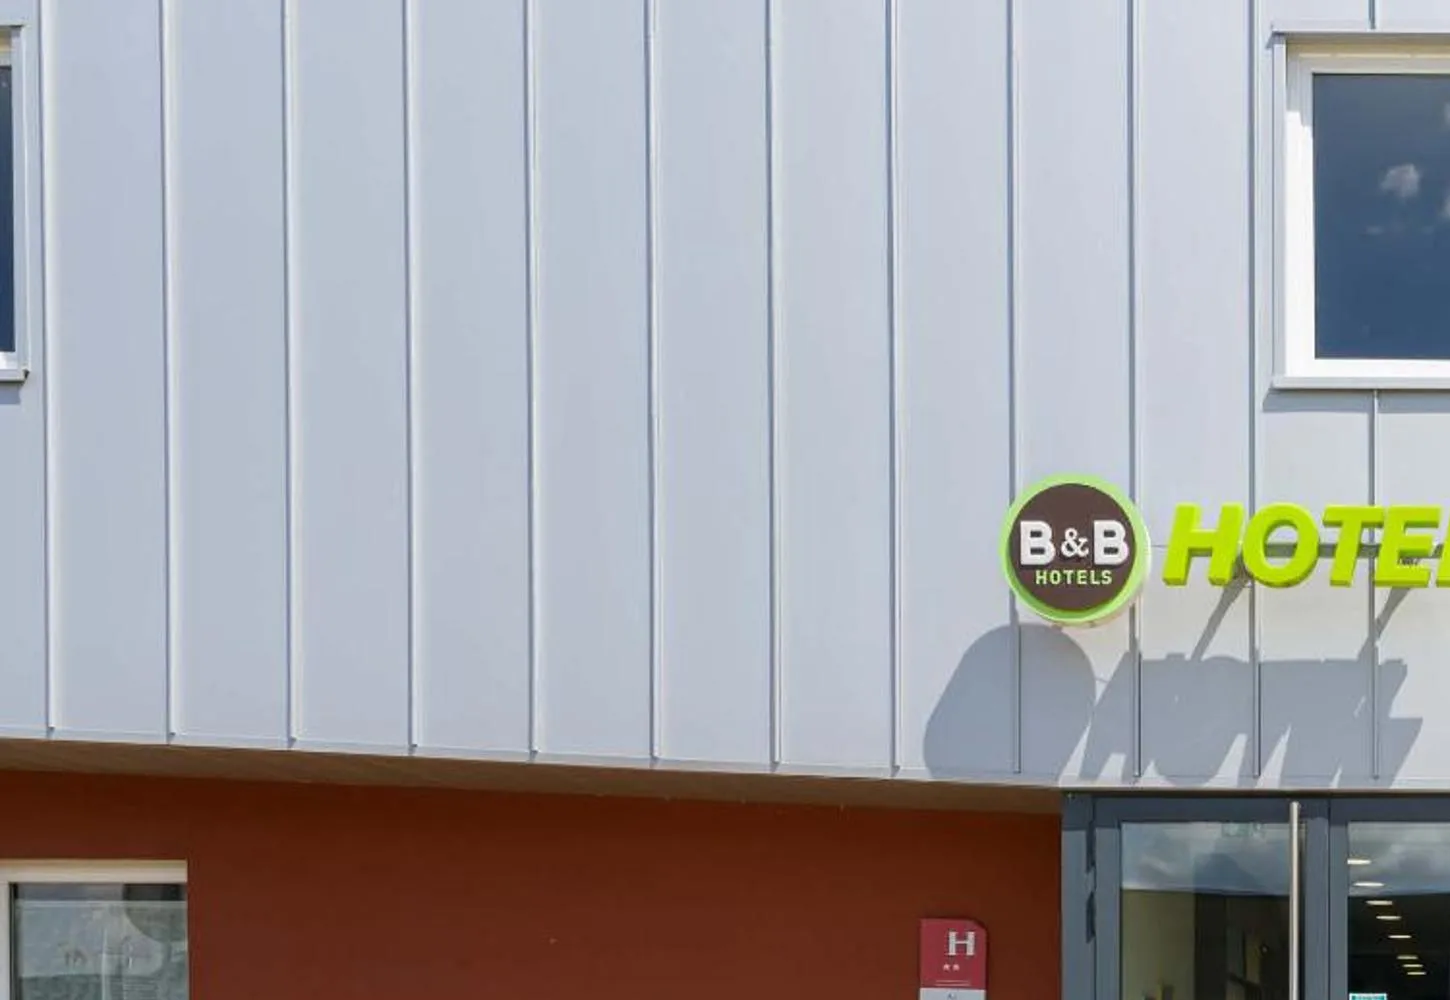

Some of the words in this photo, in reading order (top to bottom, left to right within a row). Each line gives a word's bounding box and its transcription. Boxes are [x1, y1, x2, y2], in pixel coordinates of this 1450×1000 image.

[1019, 519, 1130, 566] B&B
[1035, 569, 1113, 586] HOTELS
[948, 930, 976, 956] H
